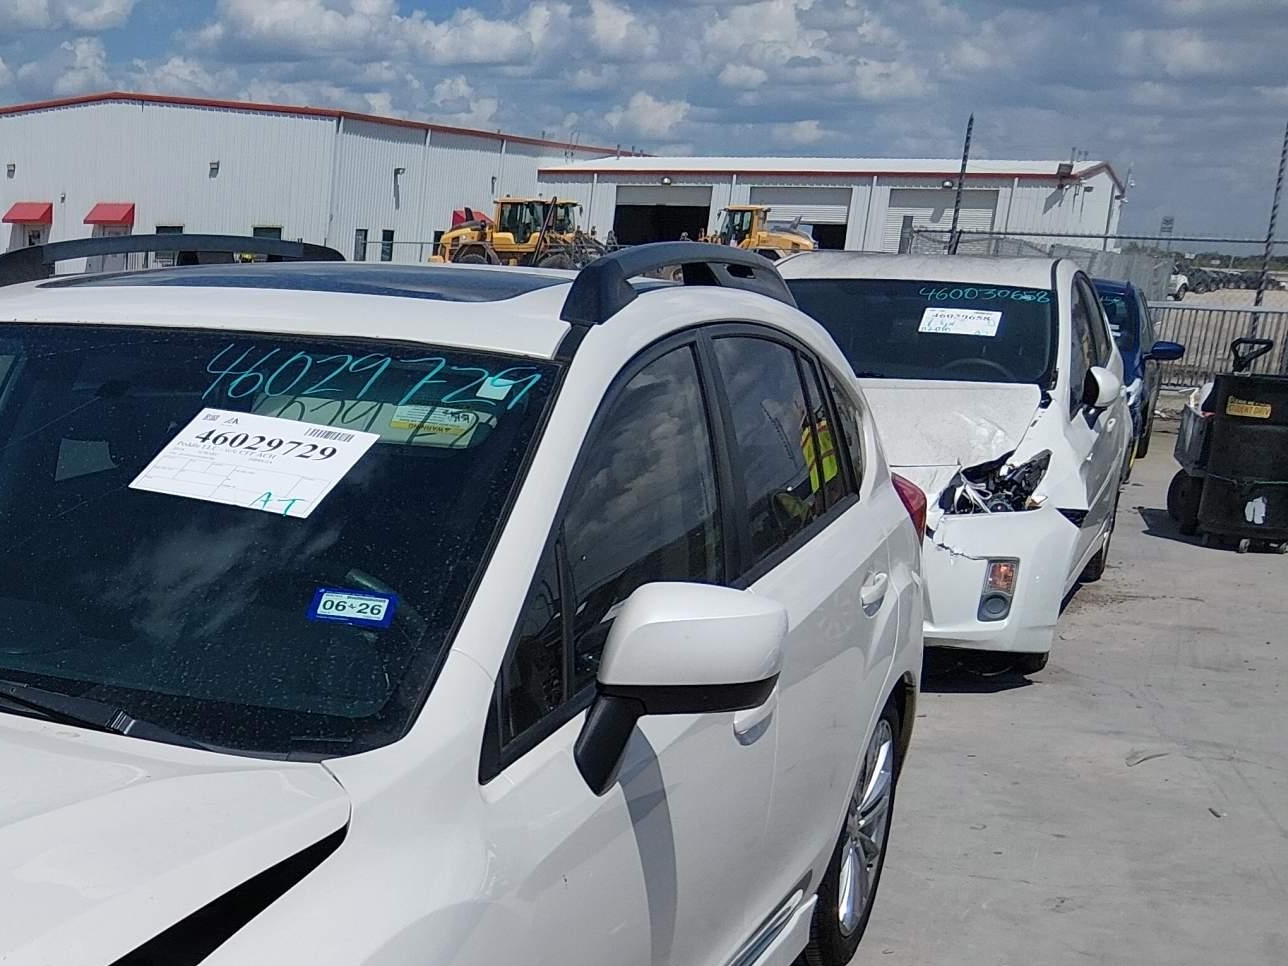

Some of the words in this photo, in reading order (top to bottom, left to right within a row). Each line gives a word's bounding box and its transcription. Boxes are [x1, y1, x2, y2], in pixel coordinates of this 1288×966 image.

[202, 343, 542, 410] 46029729
[195, 428, 337, 461] 46029729
[322, 599, 347, 612] 06
[356, 602, 383, 616] 26
